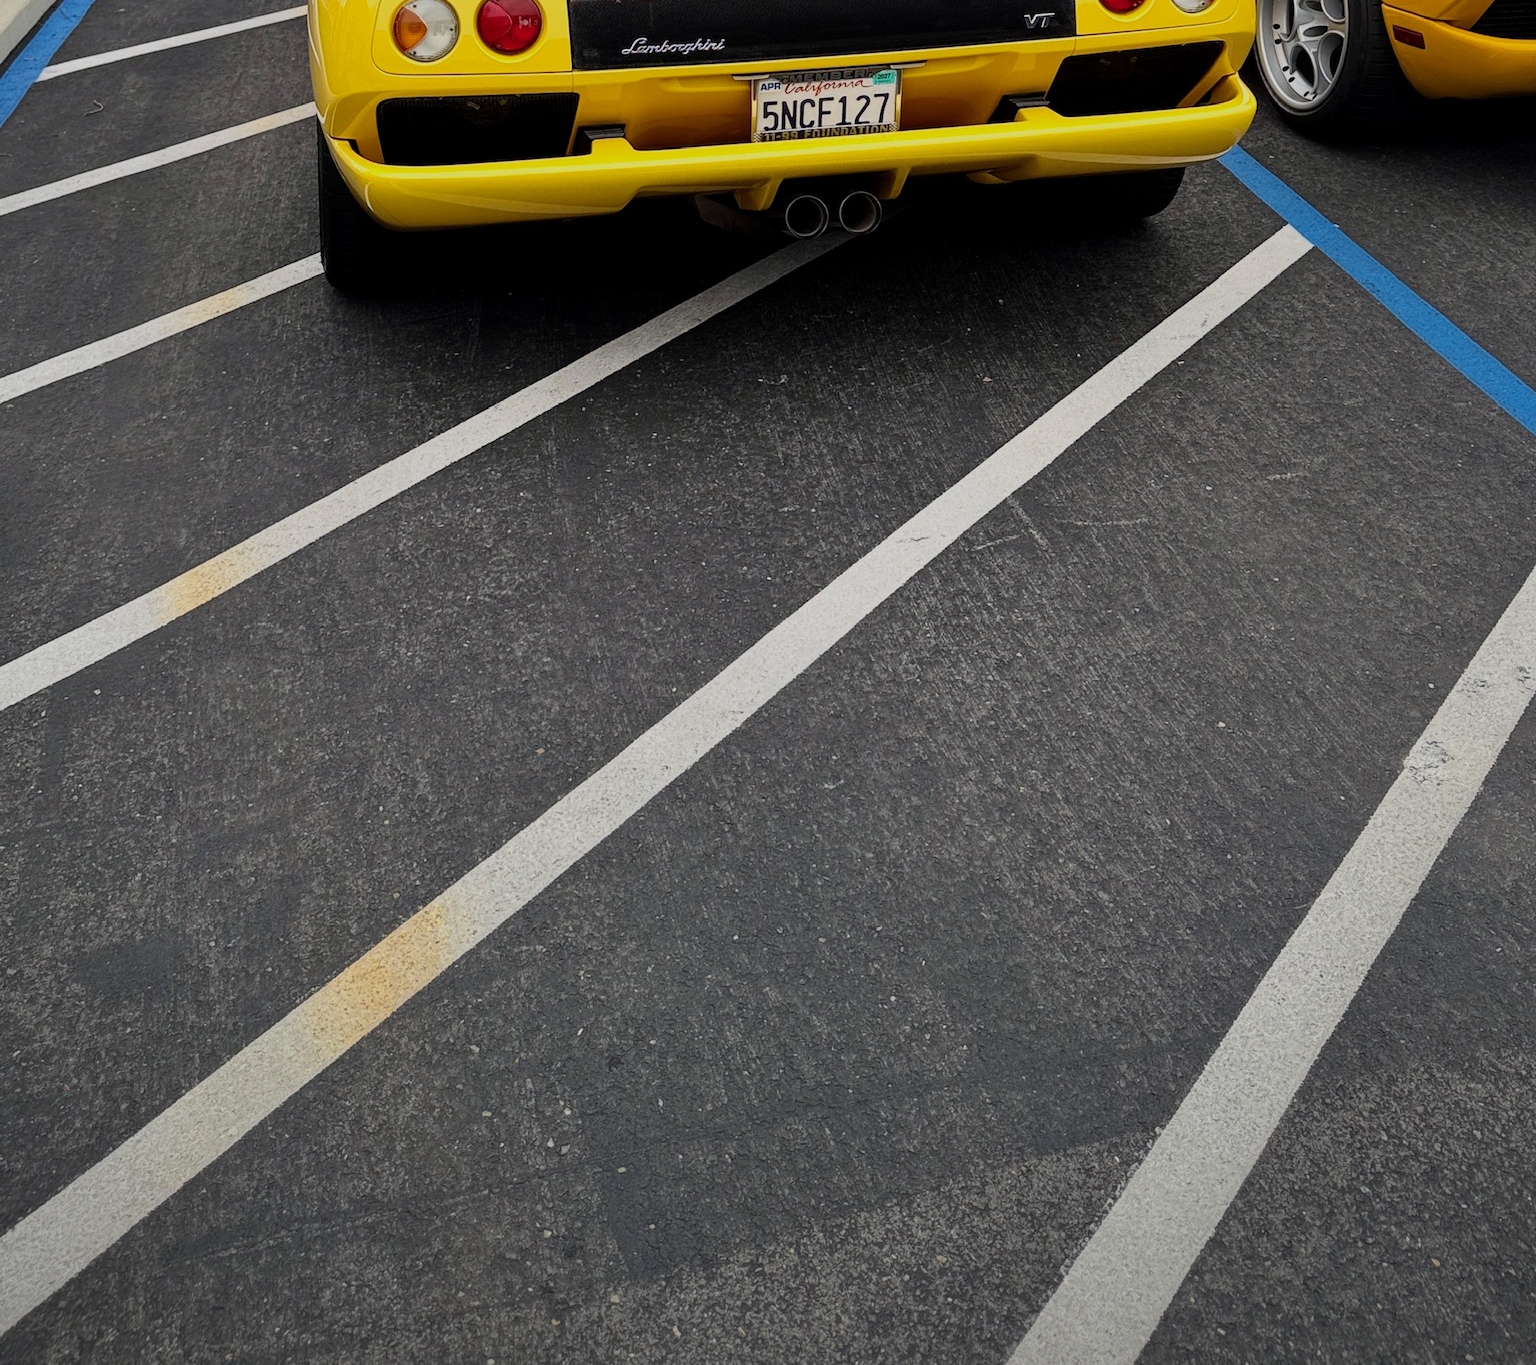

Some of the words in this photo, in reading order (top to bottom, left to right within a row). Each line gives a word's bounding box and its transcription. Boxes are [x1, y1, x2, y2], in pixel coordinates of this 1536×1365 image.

[1024, 12, 1055, 29] VT
[621, 37, 726, 55] Lamborghini
[790, 69, 865, 83] MEMBER
[760, 82, 781, 91] APR
[784, 79, 873, 97] California
[763, 92, 890, 132] 5NCF127
[803, 124, 890, 139] FOUNDATION
